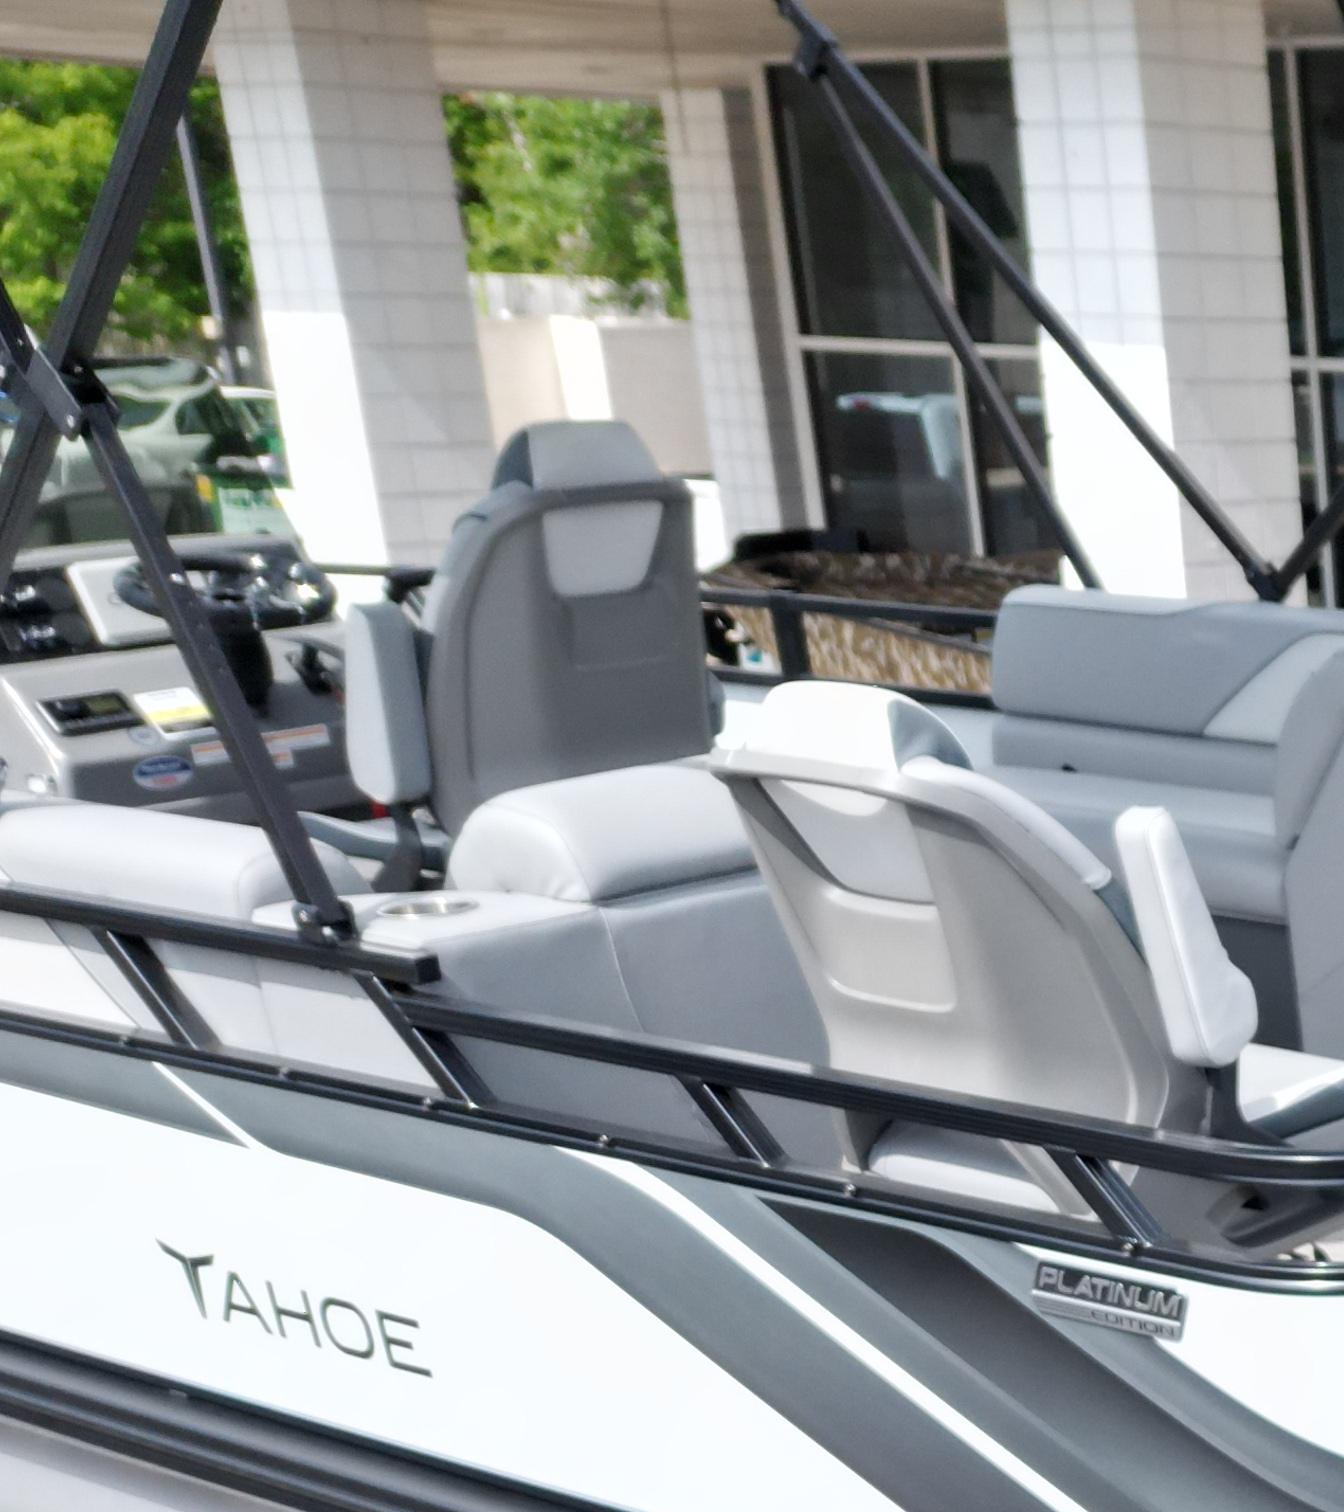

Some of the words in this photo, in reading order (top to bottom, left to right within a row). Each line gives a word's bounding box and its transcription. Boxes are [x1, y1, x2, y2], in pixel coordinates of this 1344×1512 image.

[155, 1237, 433, 1379] TAHOE
[1038, 1265, 1183, 1318] PLATINUM
[1090, 1310, 1176, 1337] EDITION
